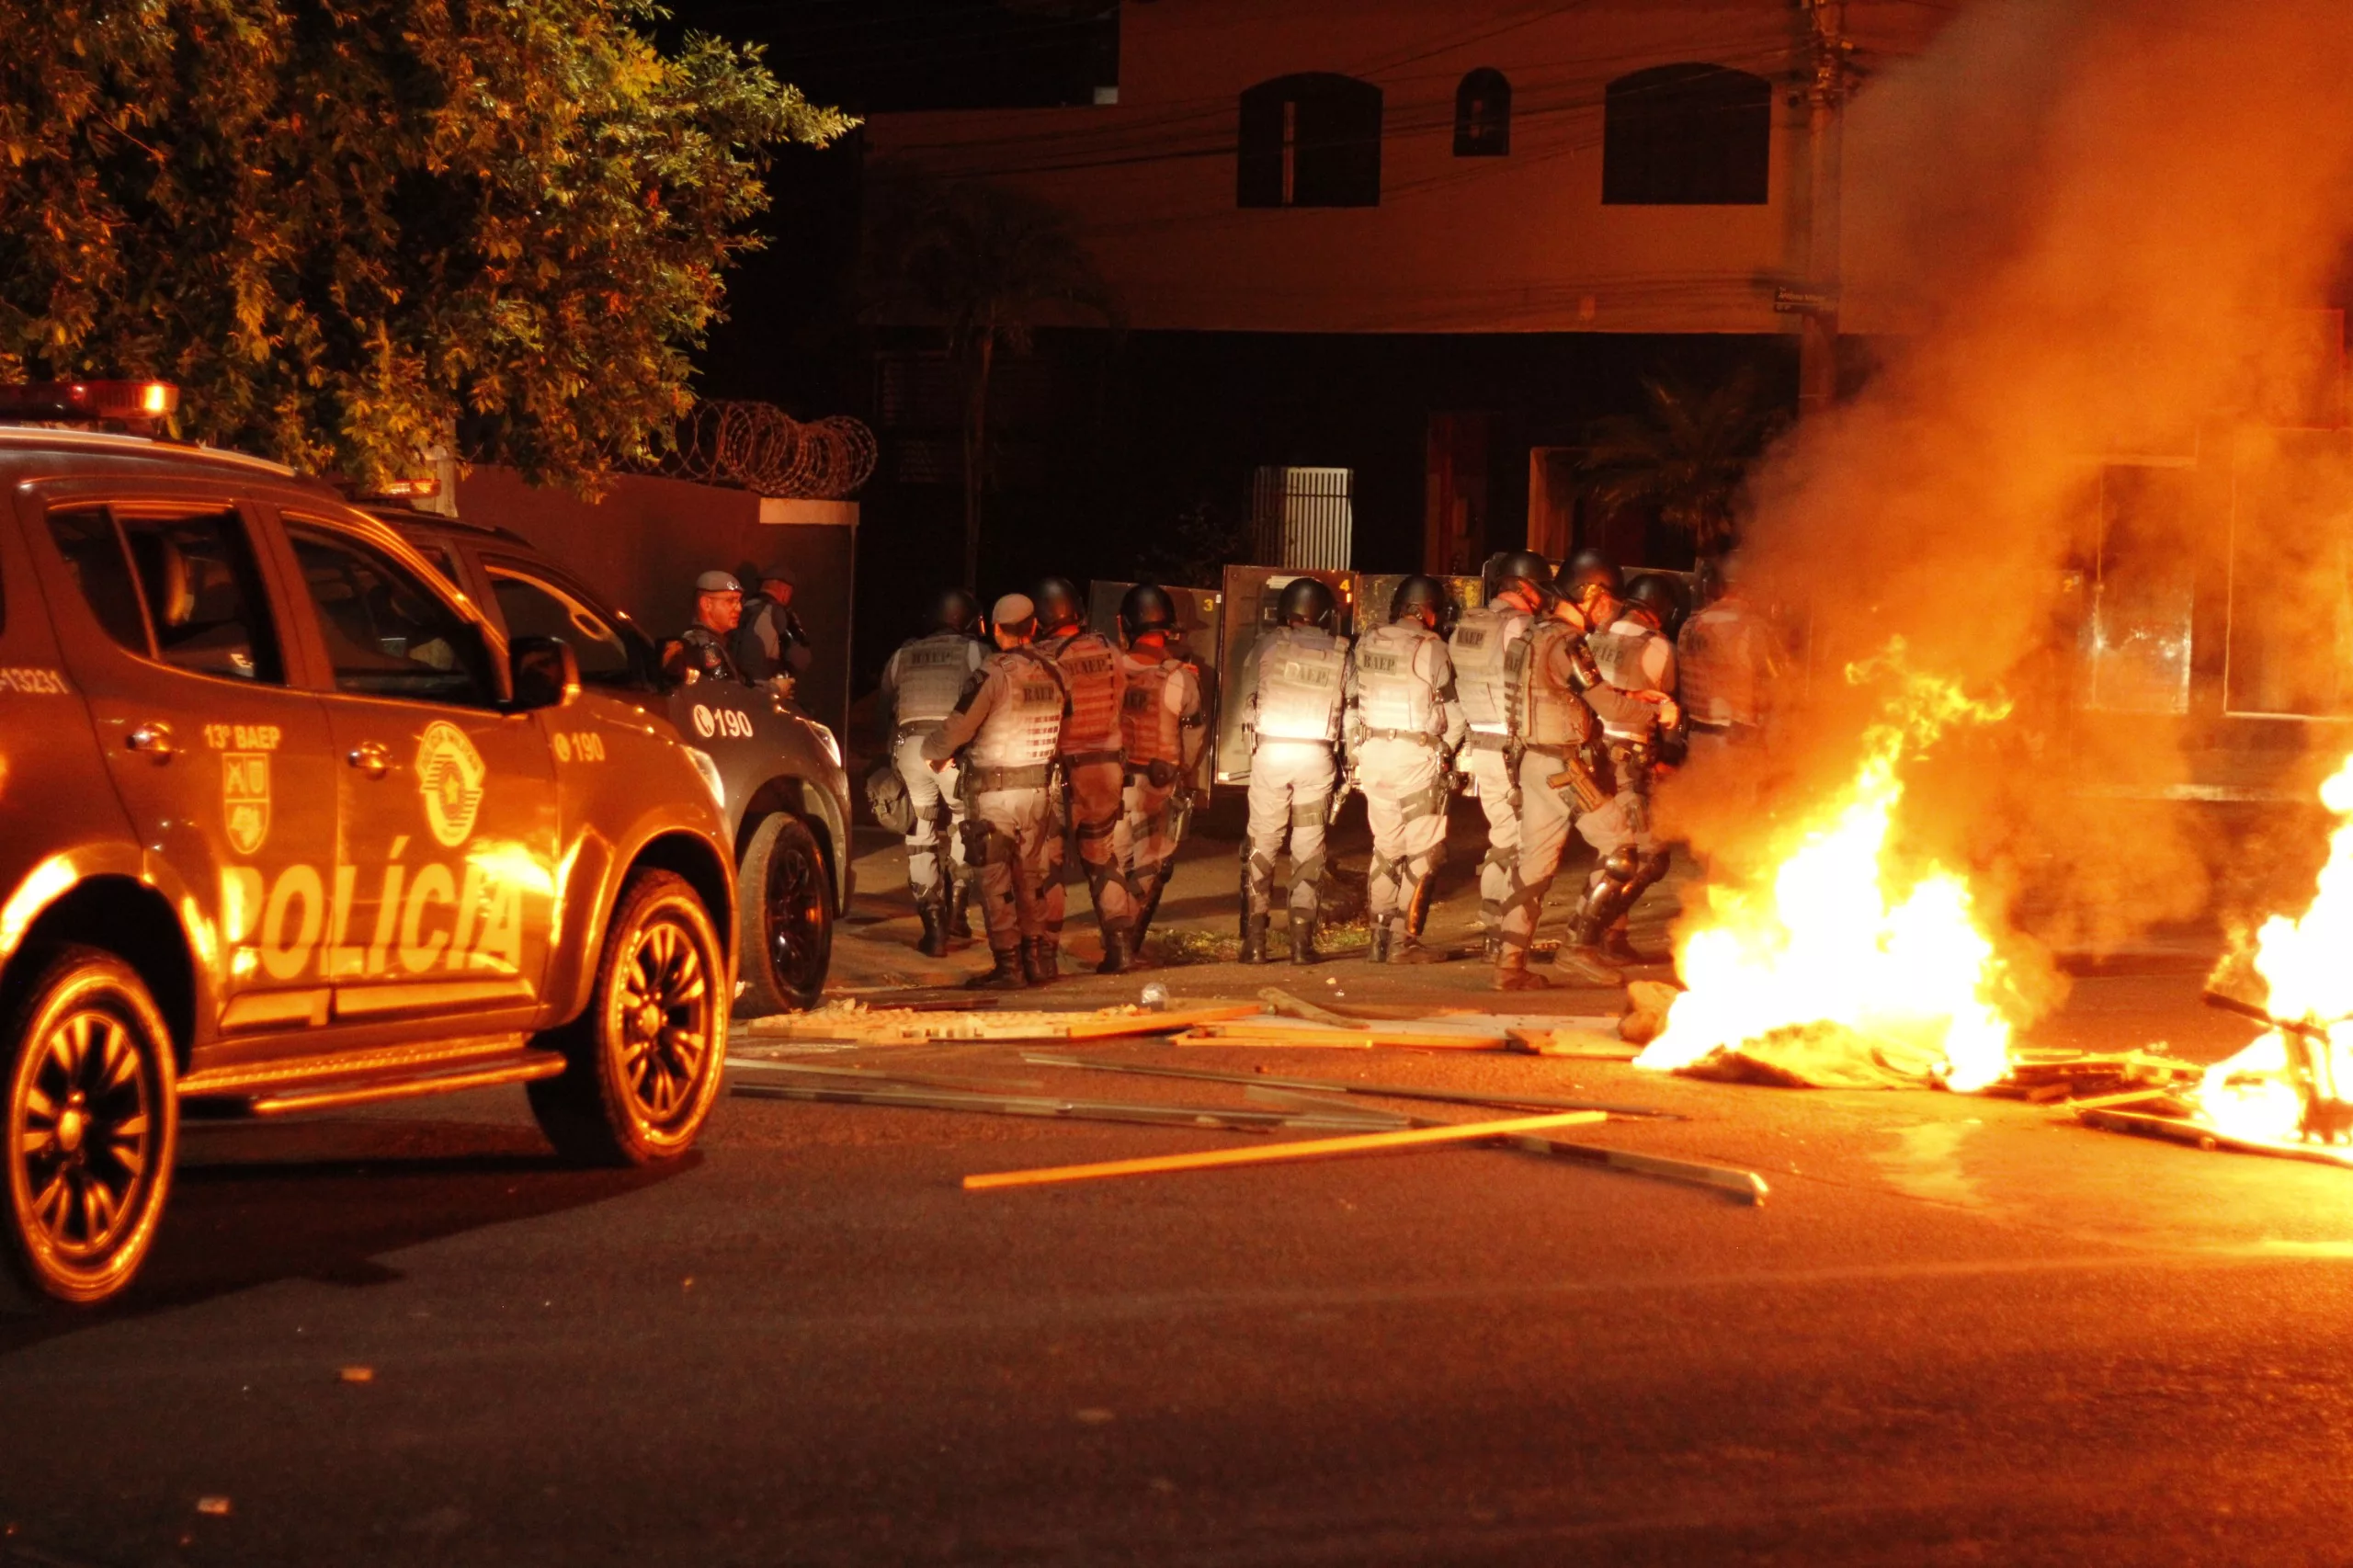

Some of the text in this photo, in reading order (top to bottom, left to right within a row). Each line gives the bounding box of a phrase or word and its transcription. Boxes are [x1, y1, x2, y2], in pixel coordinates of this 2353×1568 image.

[1203, 599, 1214, 611] 3
[1363, 653, 1395, 672] BAEP
[714, 709, 754, 737] 190
[234, 724, 280, 750] BAEP
[572, 732, 605, 761] 190
[220, 835, 521, 980] POLÍCIA
